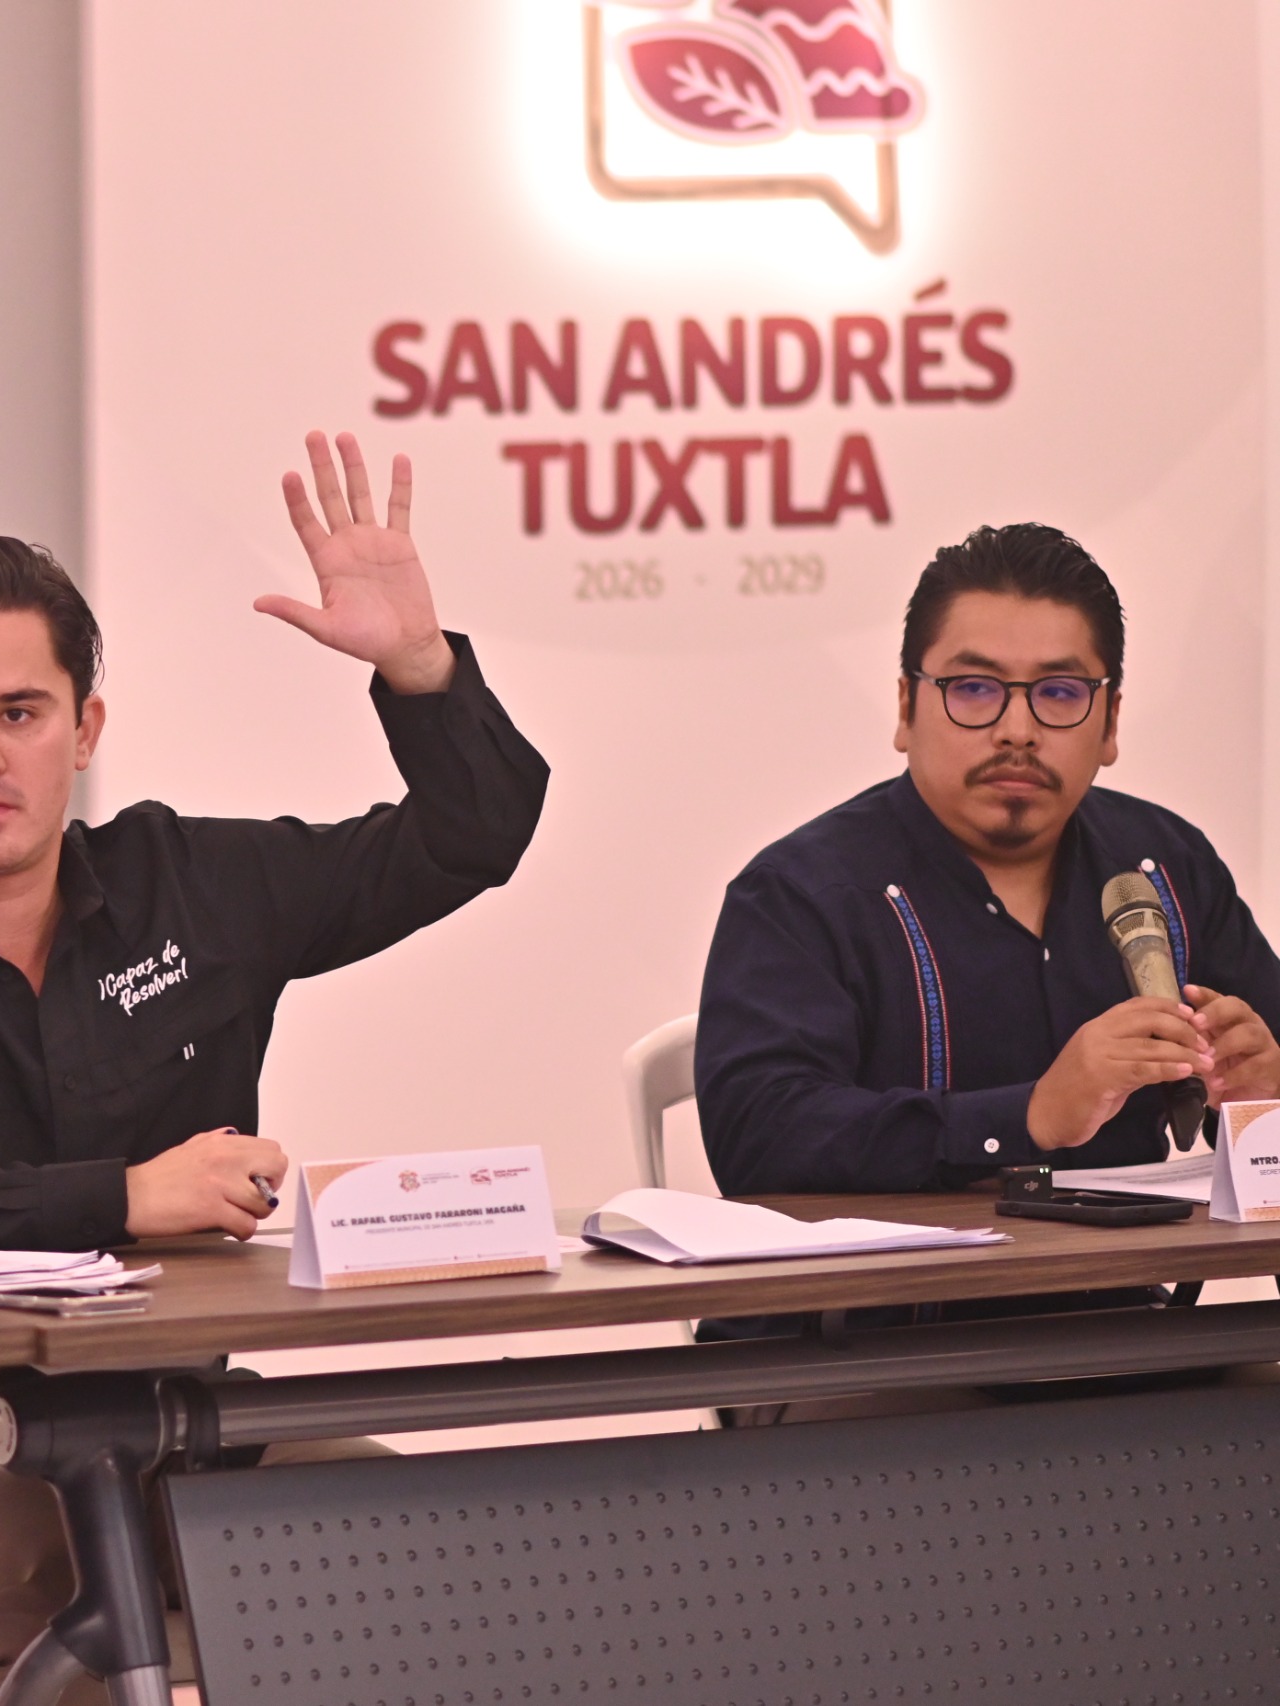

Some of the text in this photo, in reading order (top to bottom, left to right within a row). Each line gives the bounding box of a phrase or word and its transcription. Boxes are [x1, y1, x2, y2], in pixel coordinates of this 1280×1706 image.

[371, 277, 1015, 418] SAN ANDRÉS
[501, 432, 892, 536] TUXTLA
[574, 557, 666, 601] 2026
[736, 552, 828, 598] 2029
[162, 939, 180, 966] de
[119, 956, 189, 1016] Resolver!
[351, 1215, 387, 1226] RAFAEL
[389, 1211, 433, 1223] GUSTAVO
[435, 1208, 484, 1220] FARARONI
[486, 1203, 526, 1216] MAGAÑA
